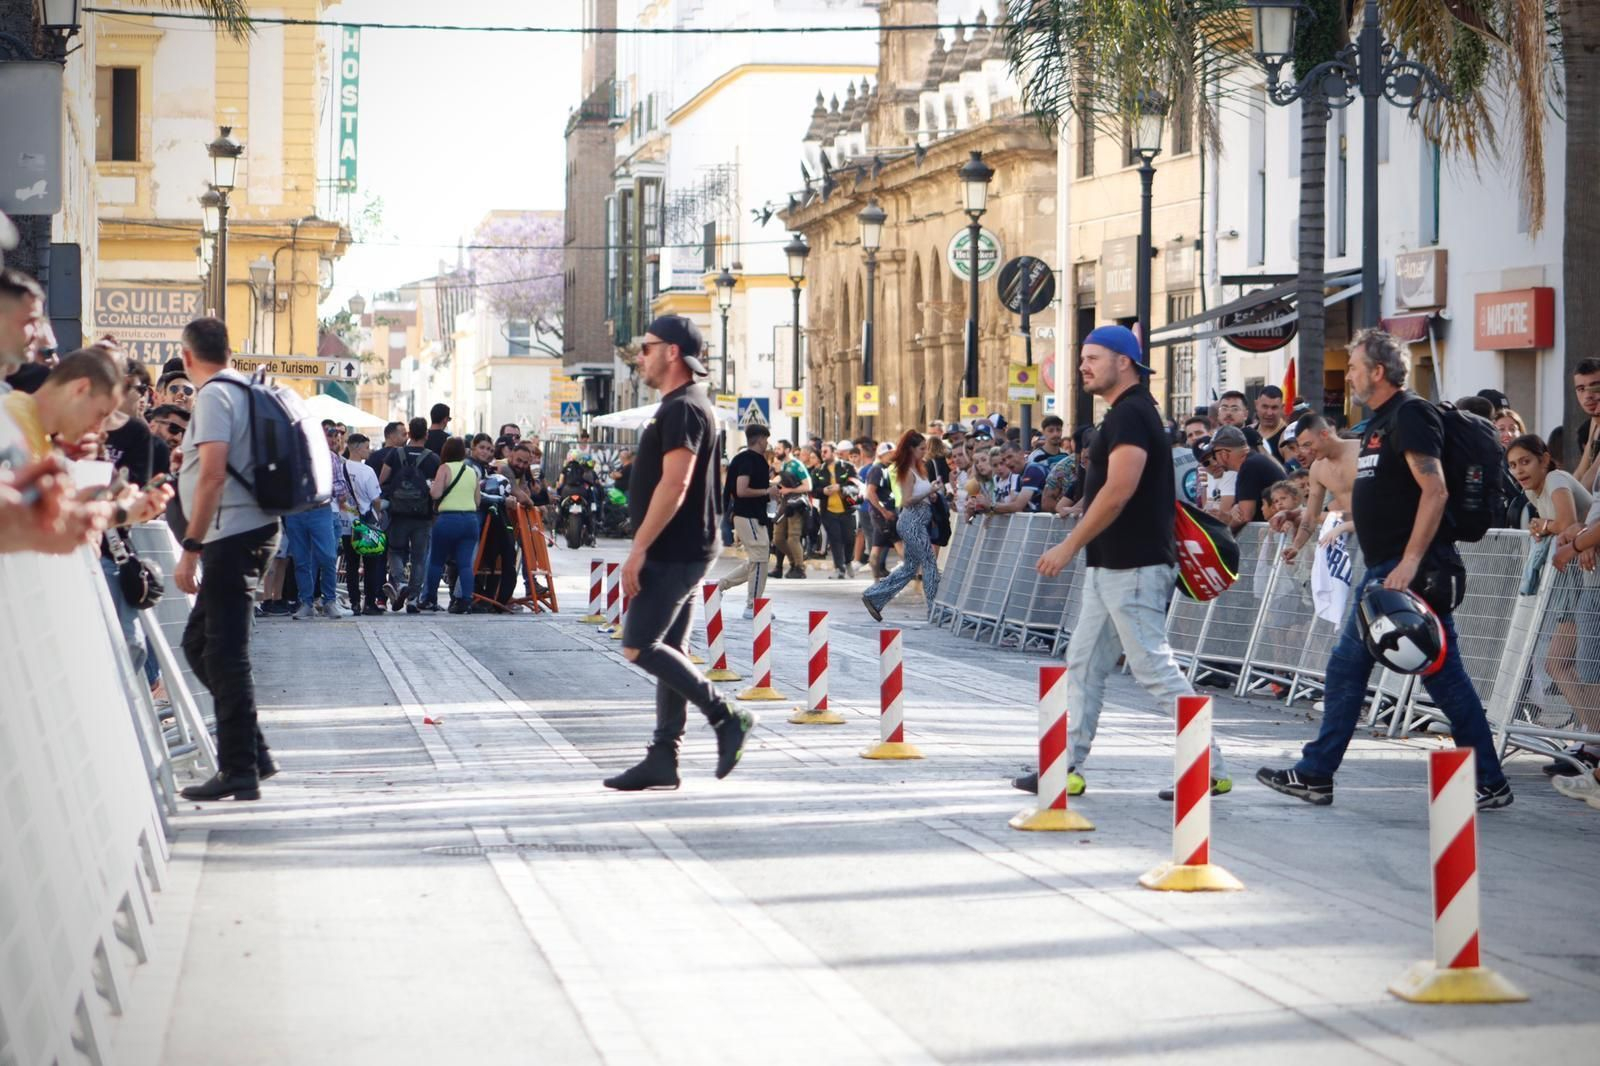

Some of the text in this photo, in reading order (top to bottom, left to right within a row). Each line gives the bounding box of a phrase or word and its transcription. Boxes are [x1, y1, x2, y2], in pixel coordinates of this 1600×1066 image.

[340, 31, 359, 187] HOSTAL
[955, 250, 996, 259] Heiken
[95, 291, 197, 314] LQUILER
[97, 313, 193, 326] COMERCIALES
[1486, 301, 1528, 336] MAPFRE
[143, 342, 161, 363] 54
[266, 360, 278, 373] de
[281, 361, 319, 375] Turismo
